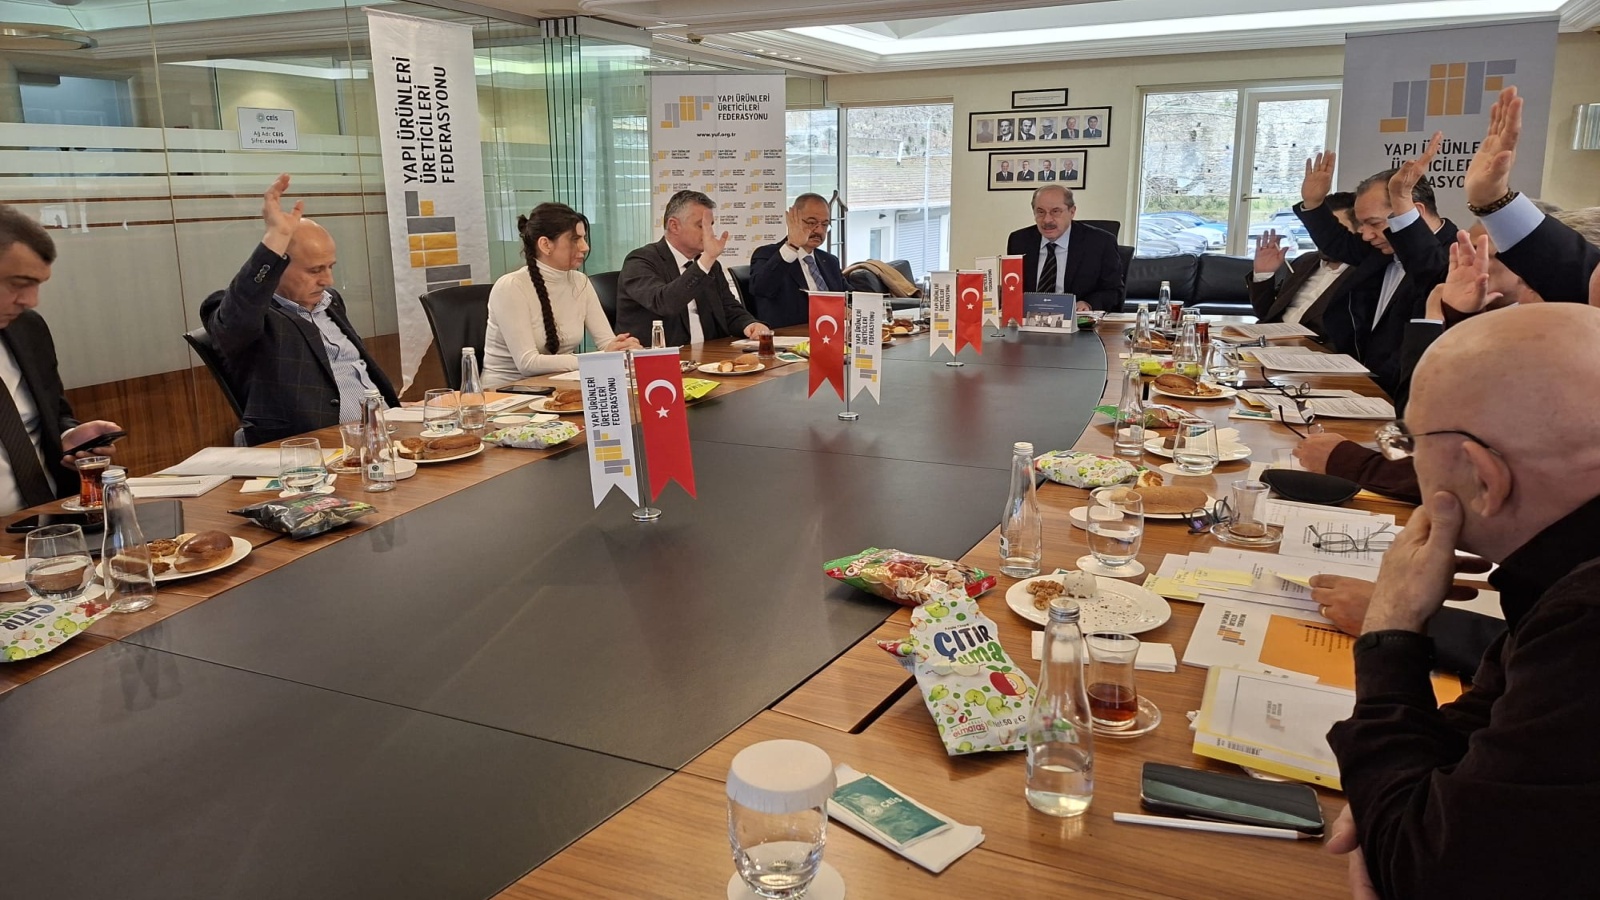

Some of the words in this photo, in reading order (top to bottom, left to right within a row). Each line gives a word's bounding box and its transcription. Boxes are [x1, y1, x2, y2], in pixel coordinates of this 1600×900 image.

[391, 56, 416, 140] ÜRÜNLERİ
[717, 103, 760, 111] ÜRETİCİLERİ
[735, 93, 770, 102] ÜRÜNLERİ
[413, 85, 438, 183] ÜRETİCİLERİ
[433, 66, 455, 183] FEDERASYONU
[401, 146, 418, 184] YAPI
[1384, 143, 1417, 155] YAPI
[585, 376, 599, 410] ÜRÜNLERİ
[596, 386, 611, 427] ÜRETİCİLERİ
[607, 377, 620, 426] FEDERASYONU
[591, 411, 600, 428] YAPI
[933, 624, 994, 663] ÇITIR
[1002, 718, 1013, 726] 50
